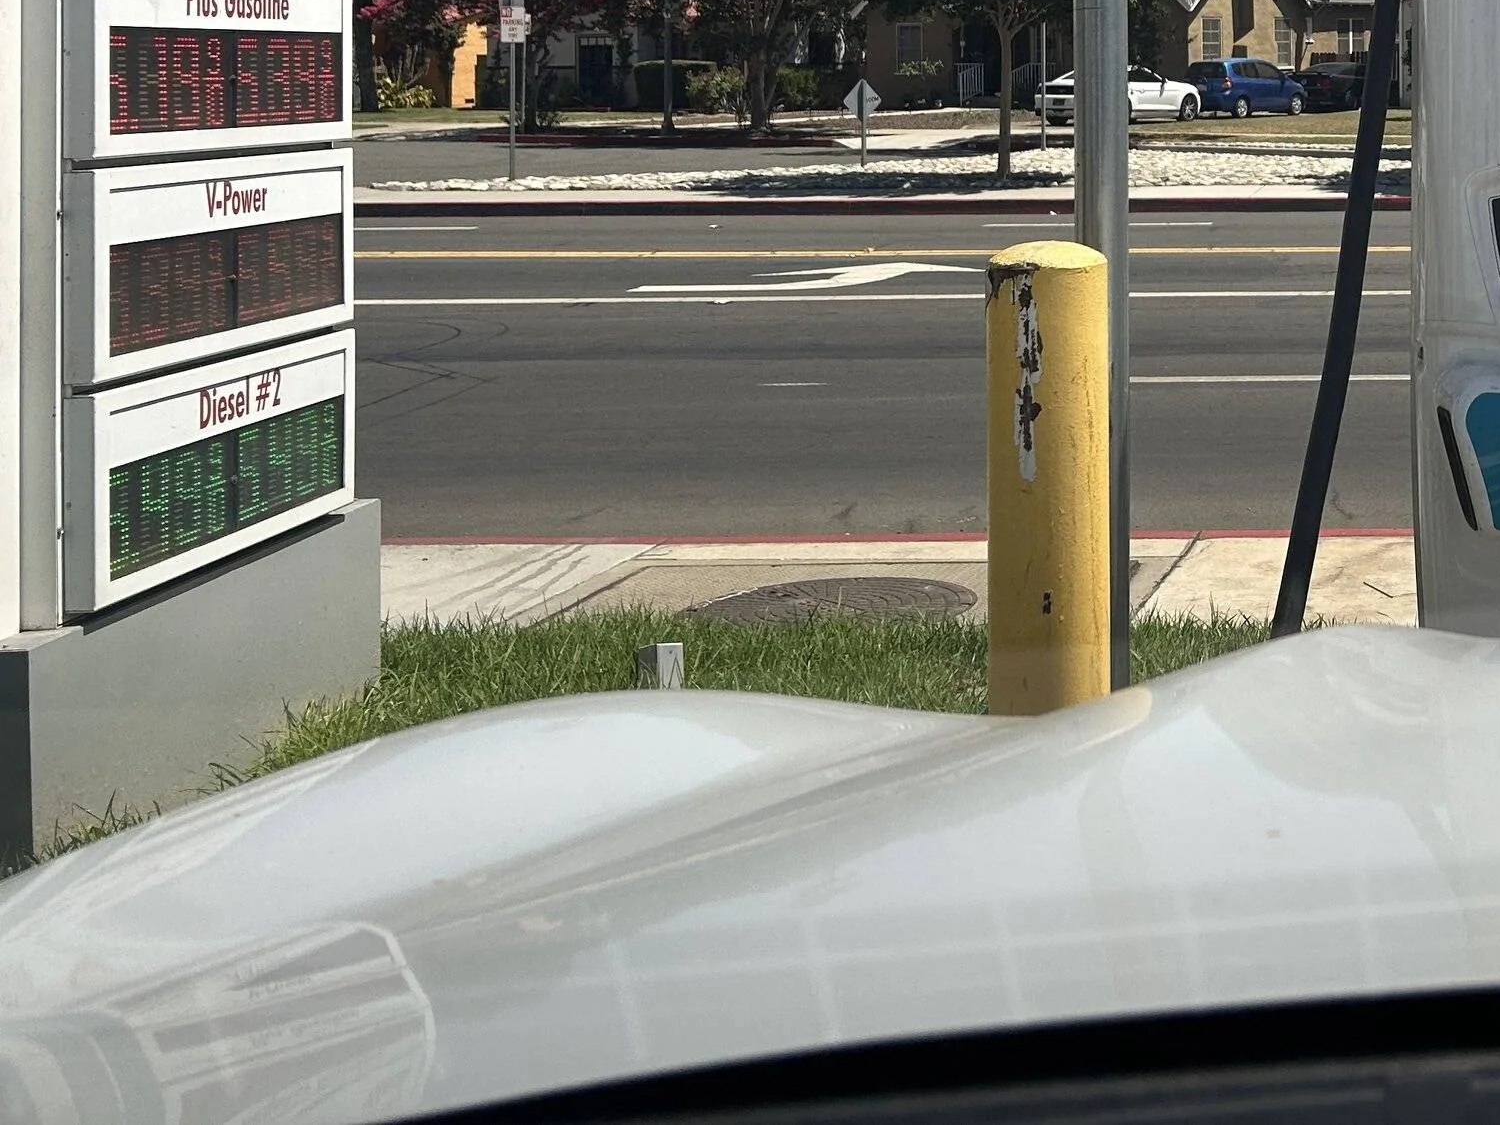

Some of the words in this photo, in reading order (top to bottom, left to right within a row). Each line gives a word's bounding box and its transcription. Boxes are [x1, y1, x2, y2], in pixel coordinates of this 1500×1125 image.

[206, 180, 268, 217] V-Power
[200, 376, 250, 430] Diesel
[255, 367, 281, 412] #2
